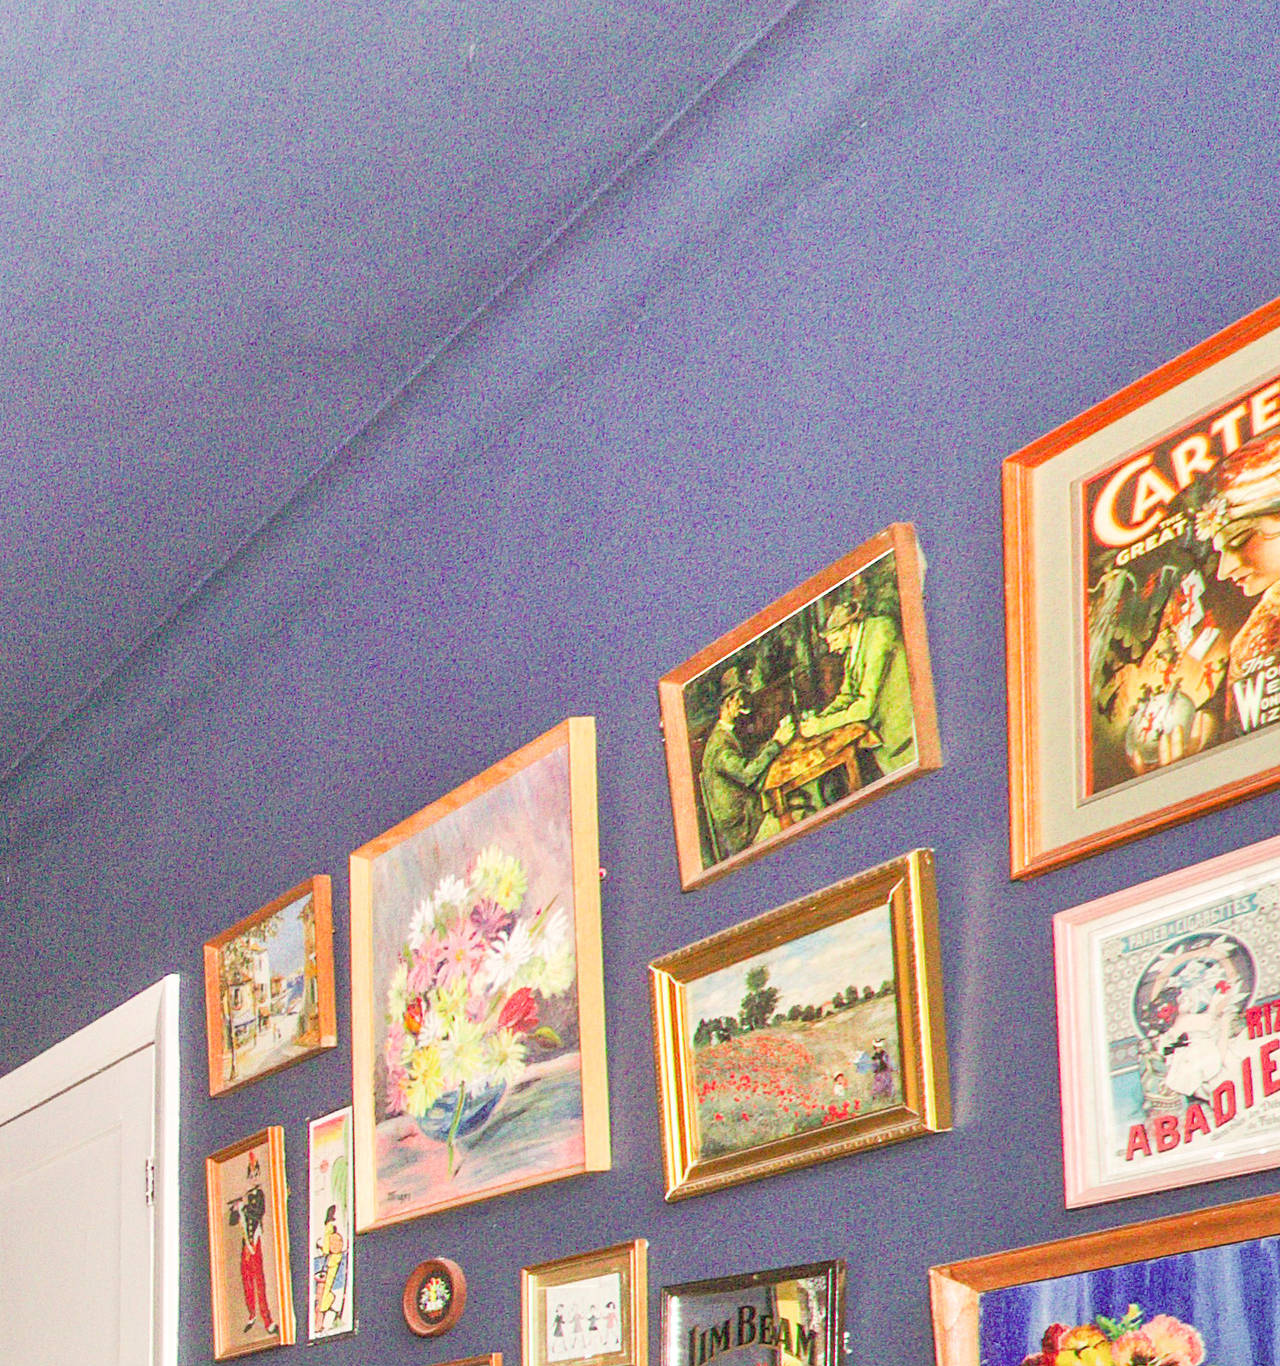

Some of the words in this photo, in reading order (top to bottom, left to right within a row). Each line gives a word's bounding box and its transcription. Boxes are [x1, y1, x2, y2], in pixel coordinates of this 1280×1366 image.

[1159, 511, 1185, 530] THE
[1115, 518, 1189, 567] GREAT
[1242, 655, 1276, 676] The
[1125, 1038, 1280, 1162] ABADIE
